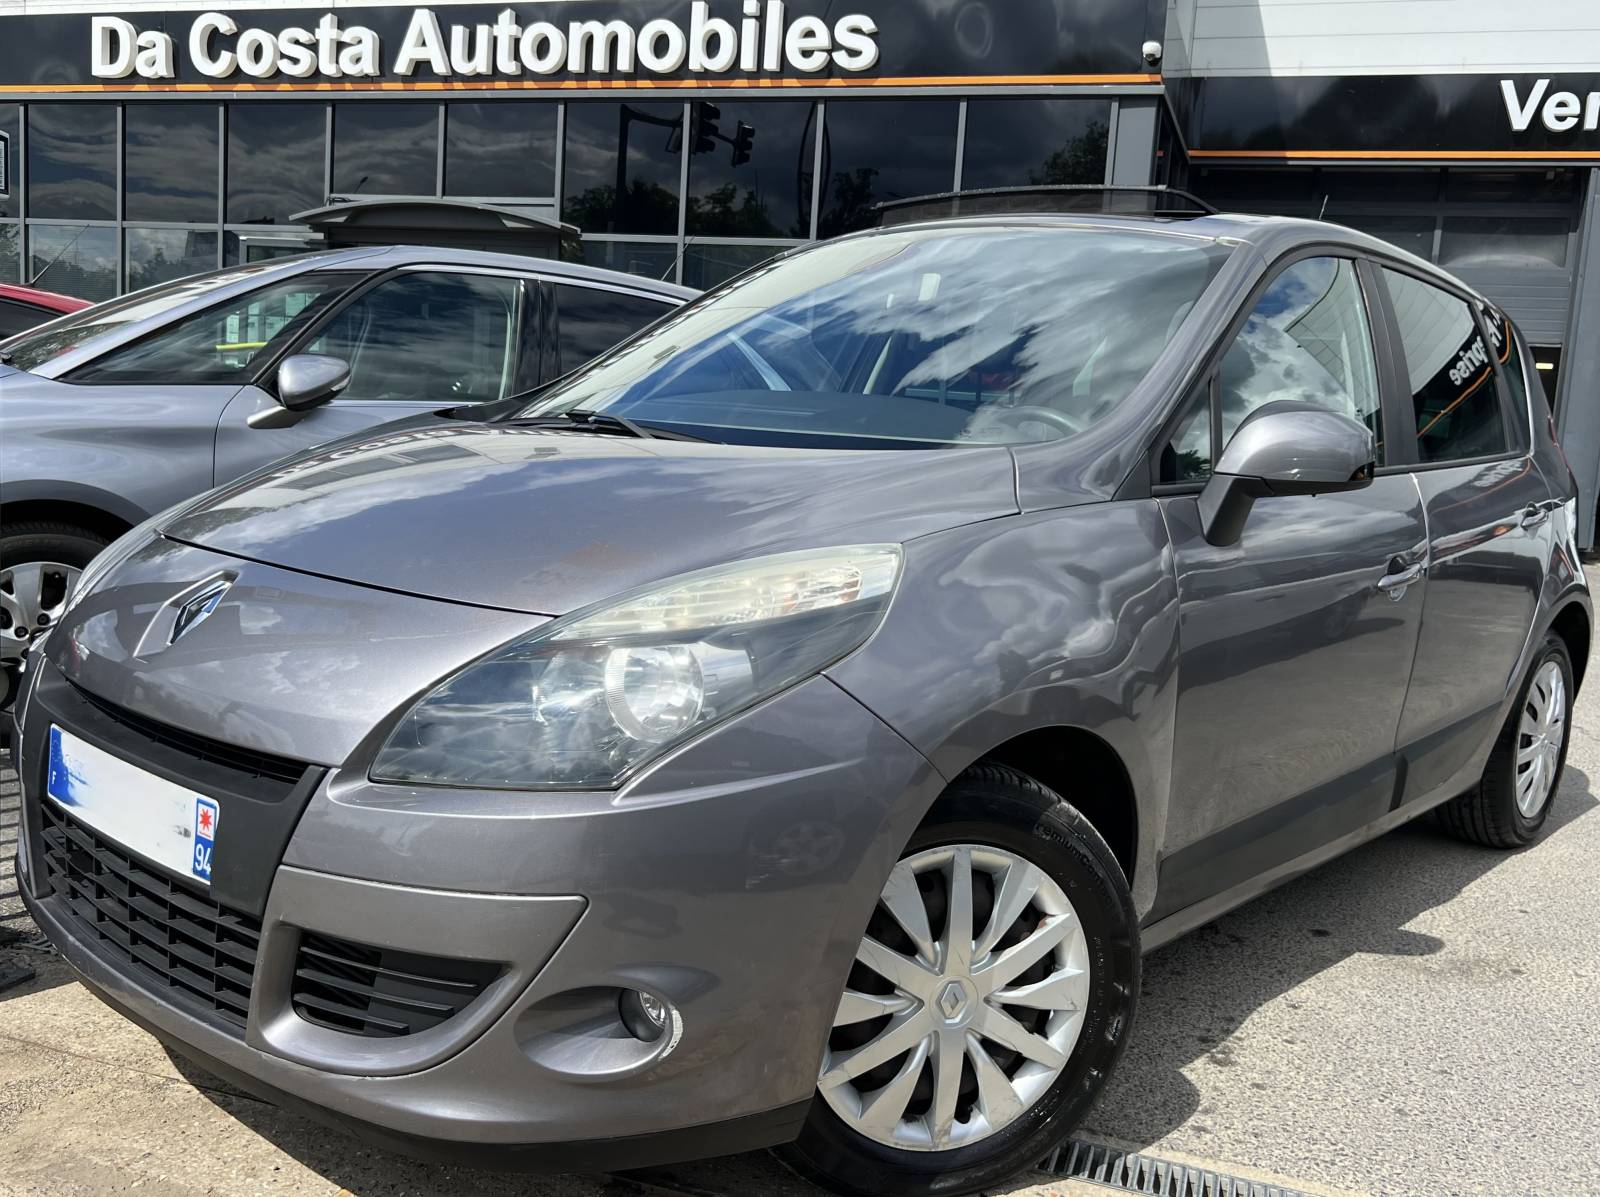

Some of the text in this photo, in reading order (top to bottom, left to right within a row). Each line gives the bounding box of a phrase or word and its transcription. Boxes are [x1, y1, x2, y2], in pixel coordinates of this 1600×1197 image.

[91, 0, 879, 79] Da Costa Automobiles
[52, 771, 57, 785] F
[195, 843, 211, 875] 94
